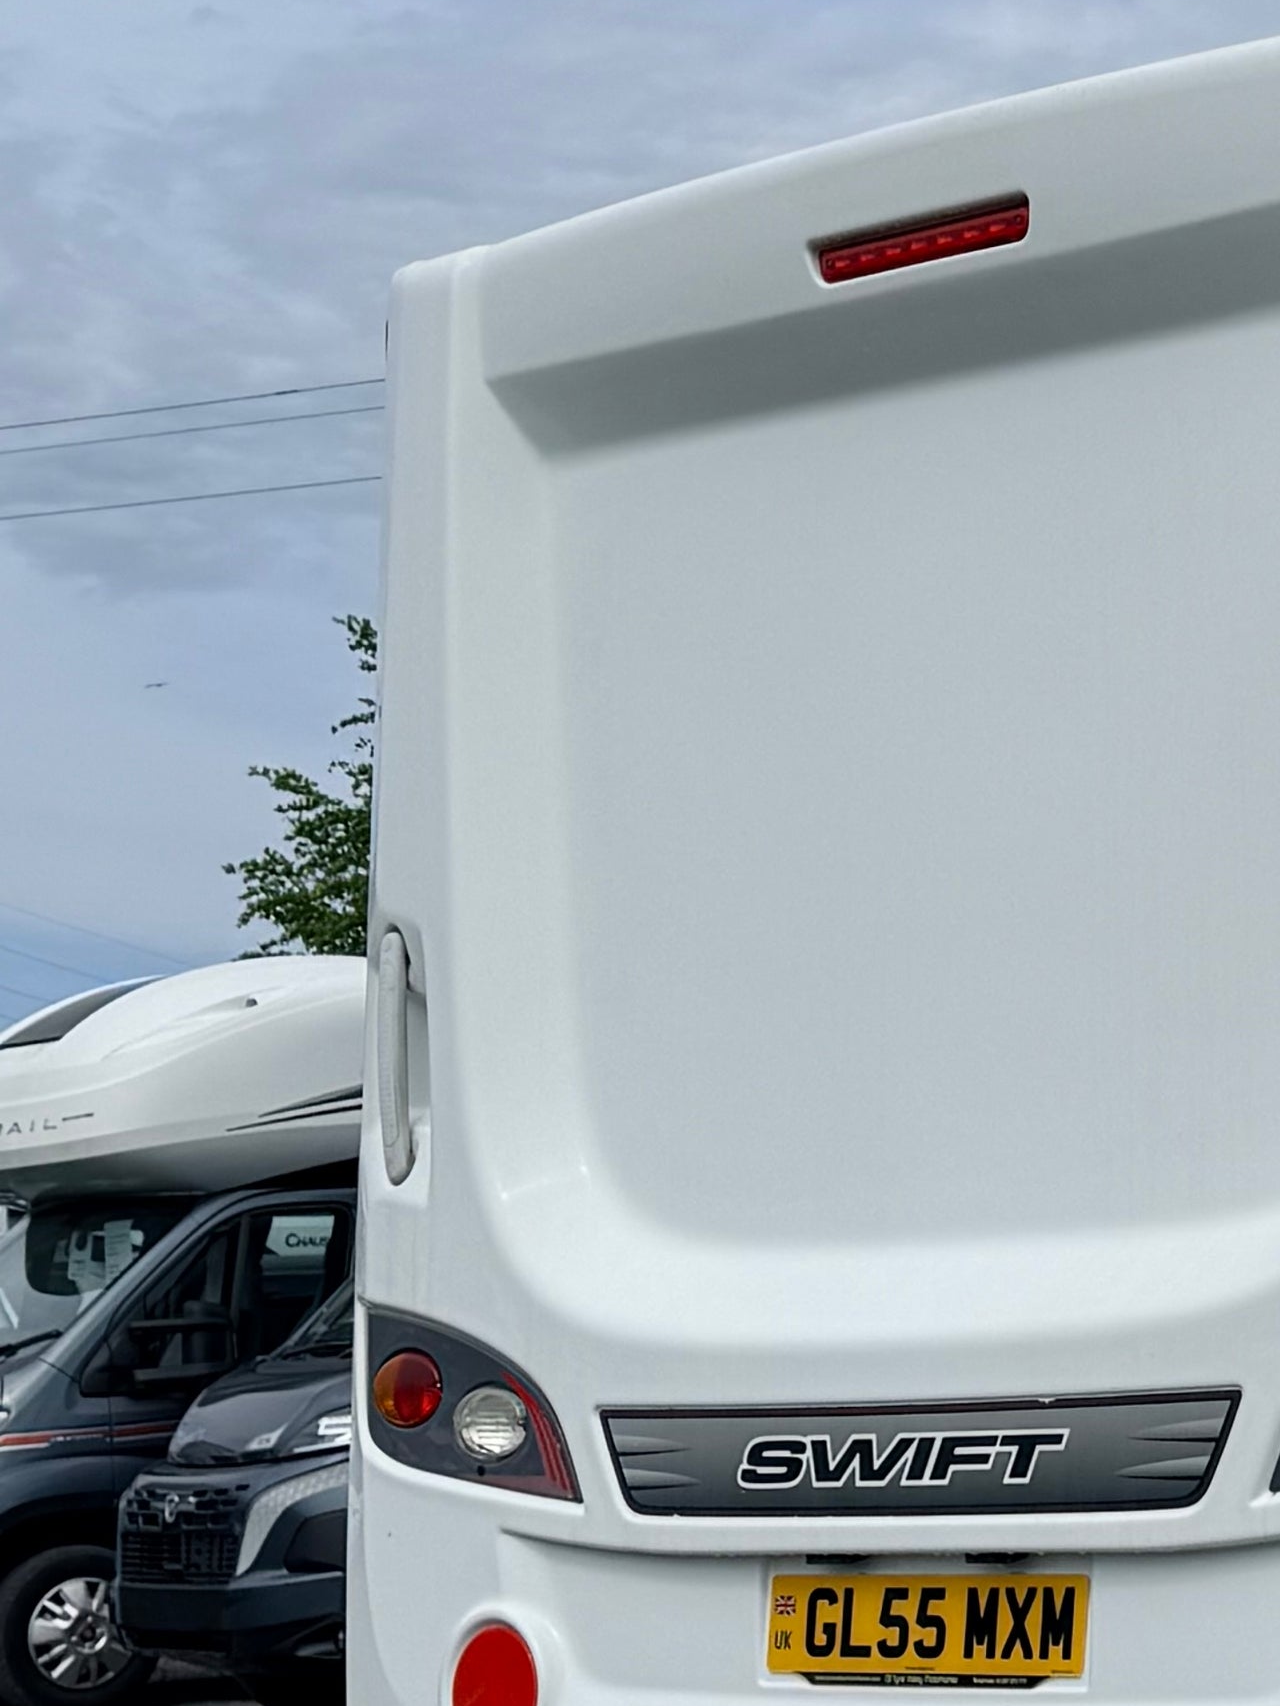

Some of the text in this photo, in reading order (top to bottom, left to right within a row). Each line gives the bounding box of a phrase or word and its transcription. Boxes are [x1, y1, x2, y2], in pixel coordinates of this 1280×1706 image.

[0, 1117, 58, 1135] AIL
[737, 1428, 1070, 1490] SWIFT
[774, 1629, 792, 1651] UK
[805, 1586, 1076, 1660] GL55 MXM
